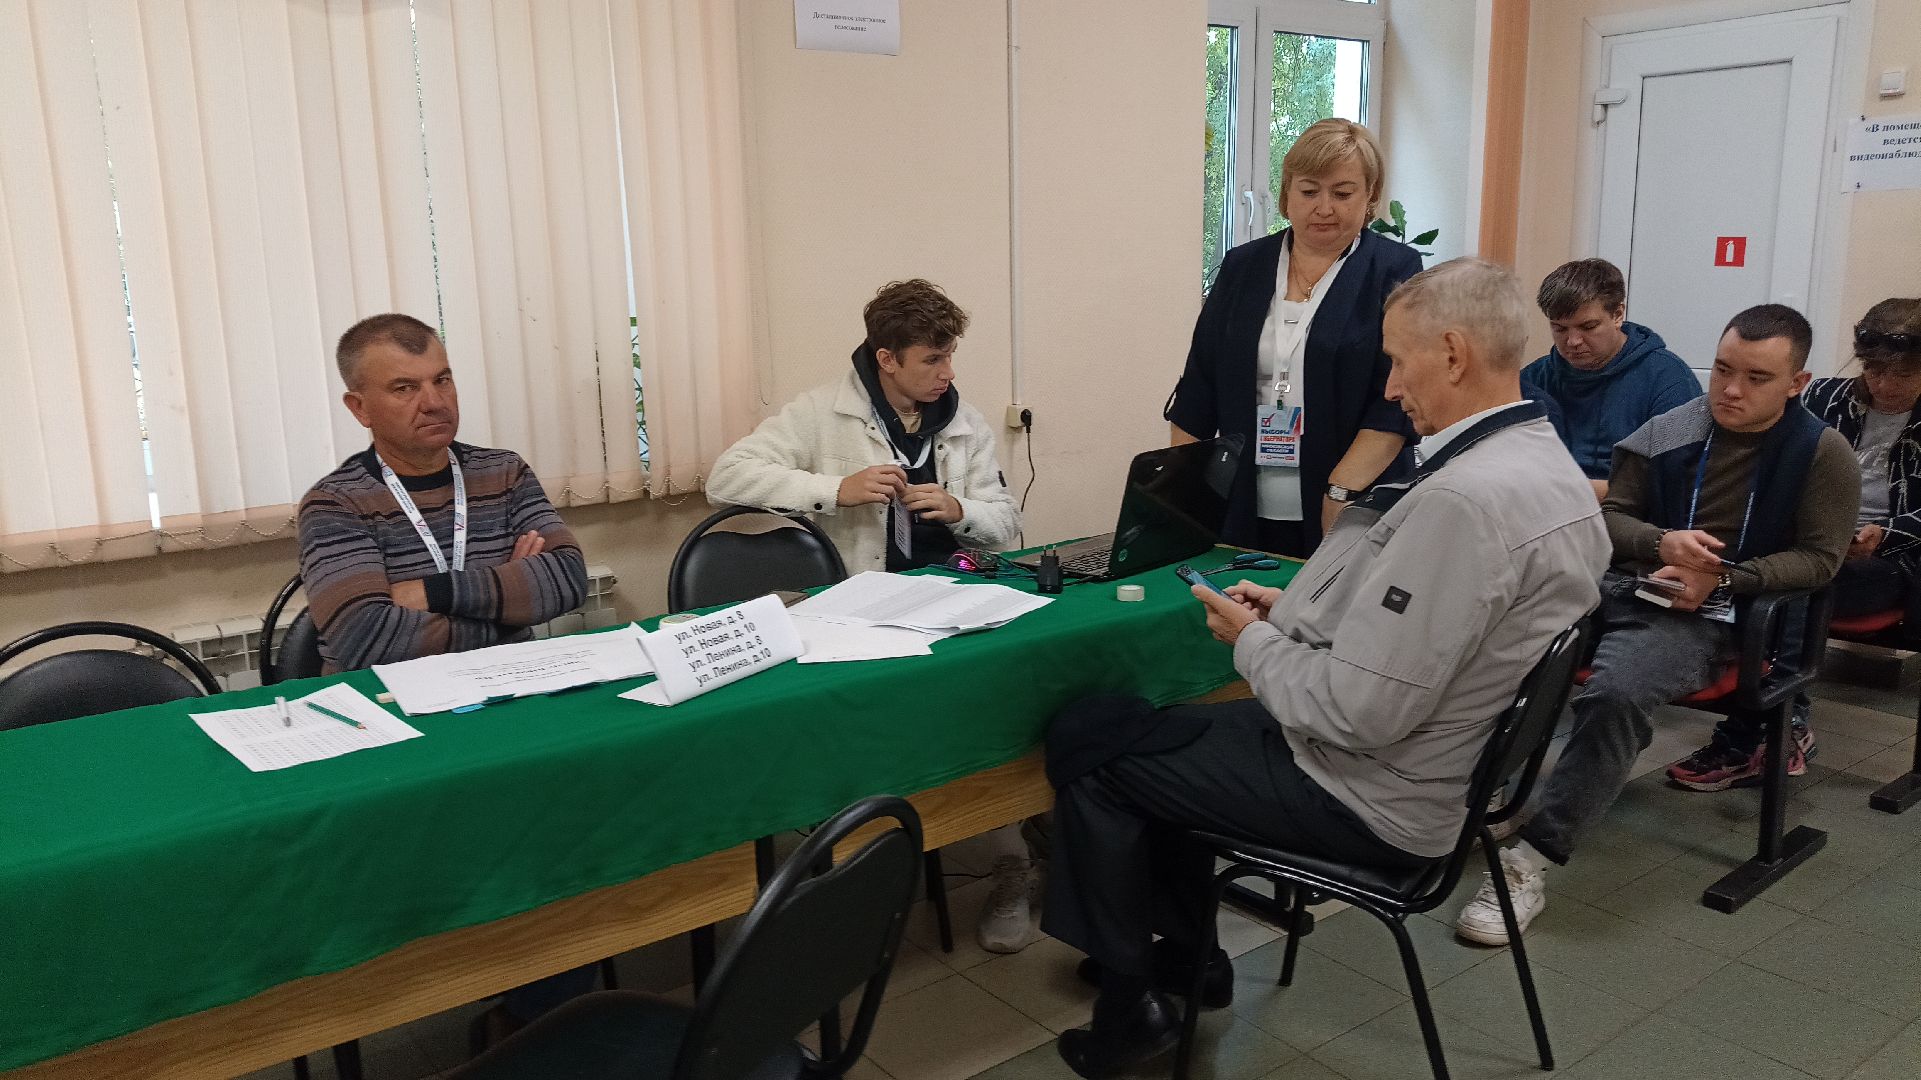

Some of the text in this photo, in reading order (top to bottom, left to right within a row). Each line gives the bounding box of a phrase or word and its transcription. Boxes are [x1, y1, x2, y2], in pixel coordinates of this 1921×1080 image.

[1882, 123, 1921, 131] помещ
[674, 610, 744, 644] ул. Новая, д. 8
[681, 622, 756, 658] ул. Новая, д. 10
[688, 635, 763, 672] ул. Ленина, д. 8
[696, 674, 712, 687] ул.
[712, 658, 751, 678] Ленина,
